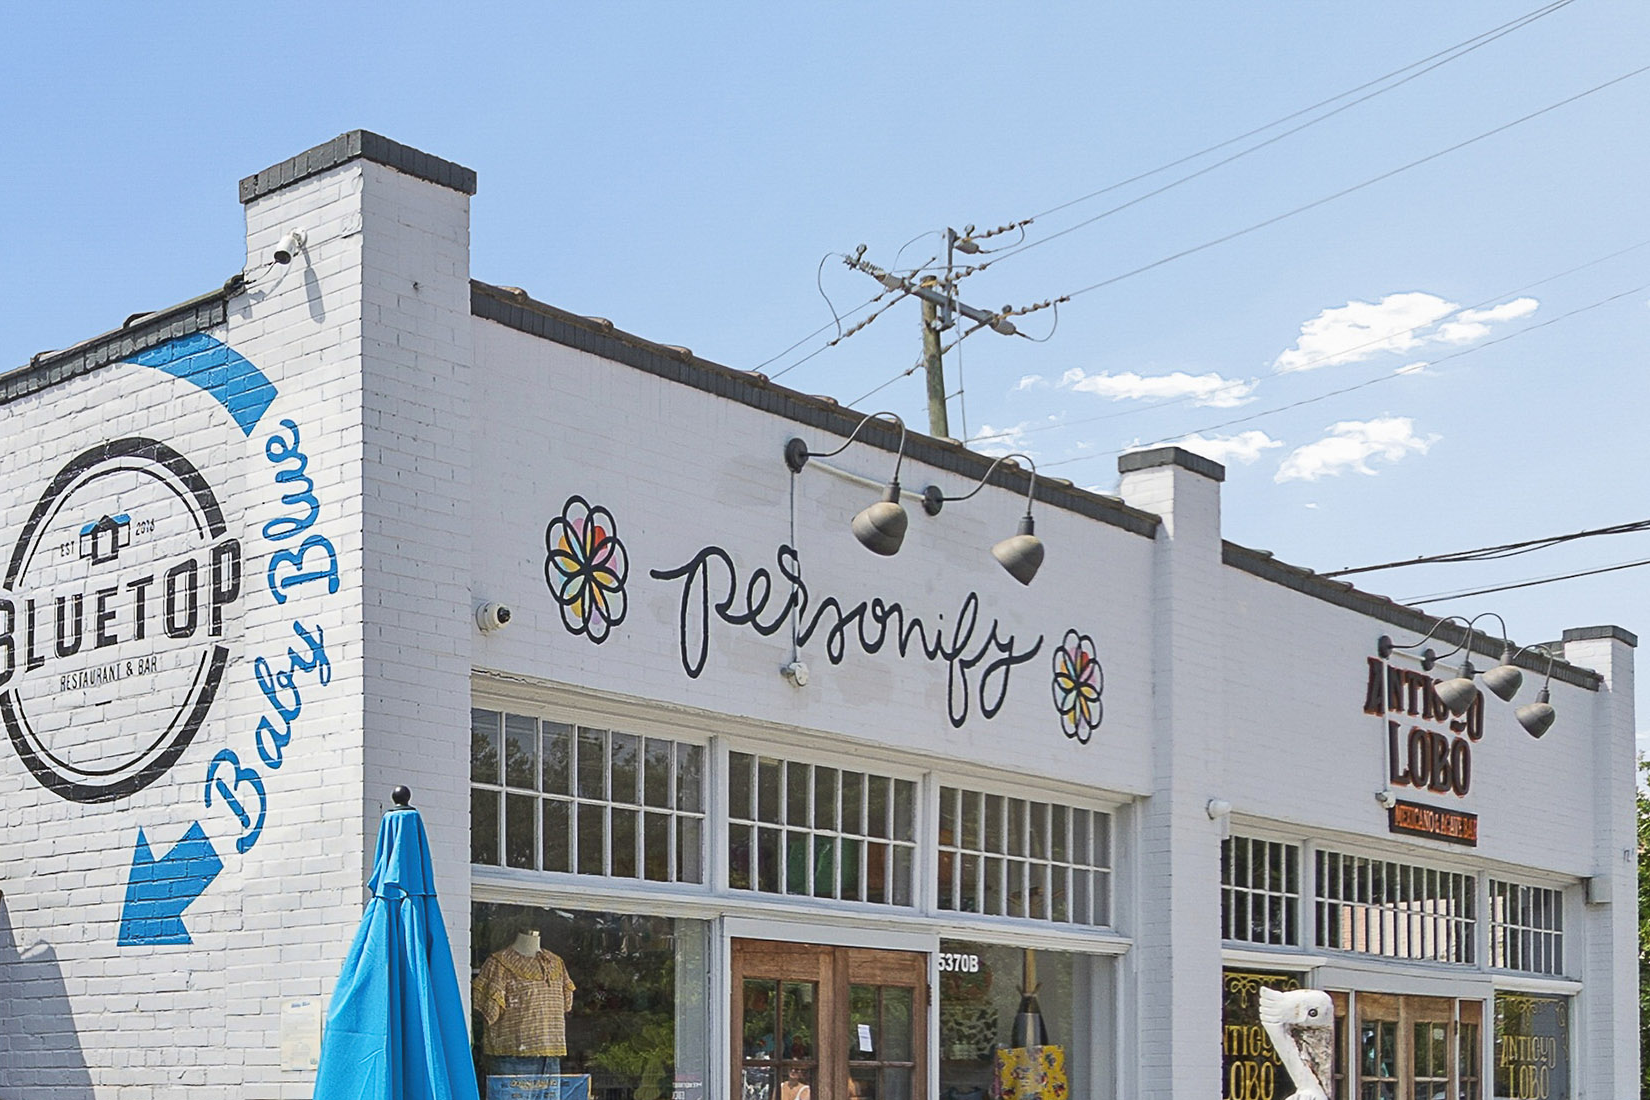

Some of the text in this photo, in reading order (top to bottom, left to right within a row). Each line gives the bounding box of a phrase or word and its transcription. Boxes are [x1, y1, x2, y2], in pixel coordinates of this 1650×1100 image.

[60, 540, 75, 557] EST
[204, 418, 340, 854] Baby Blue
[60, 655, 158, 692] RESTAURANT & BAR
[1388, 720, 1471, 798] LOBO
[937, 953, 979, 973] 5370B
[1500, 1035, 1556, 1069] ANTIGUO
[1509, 1064, 1550, 1100] LOBO
